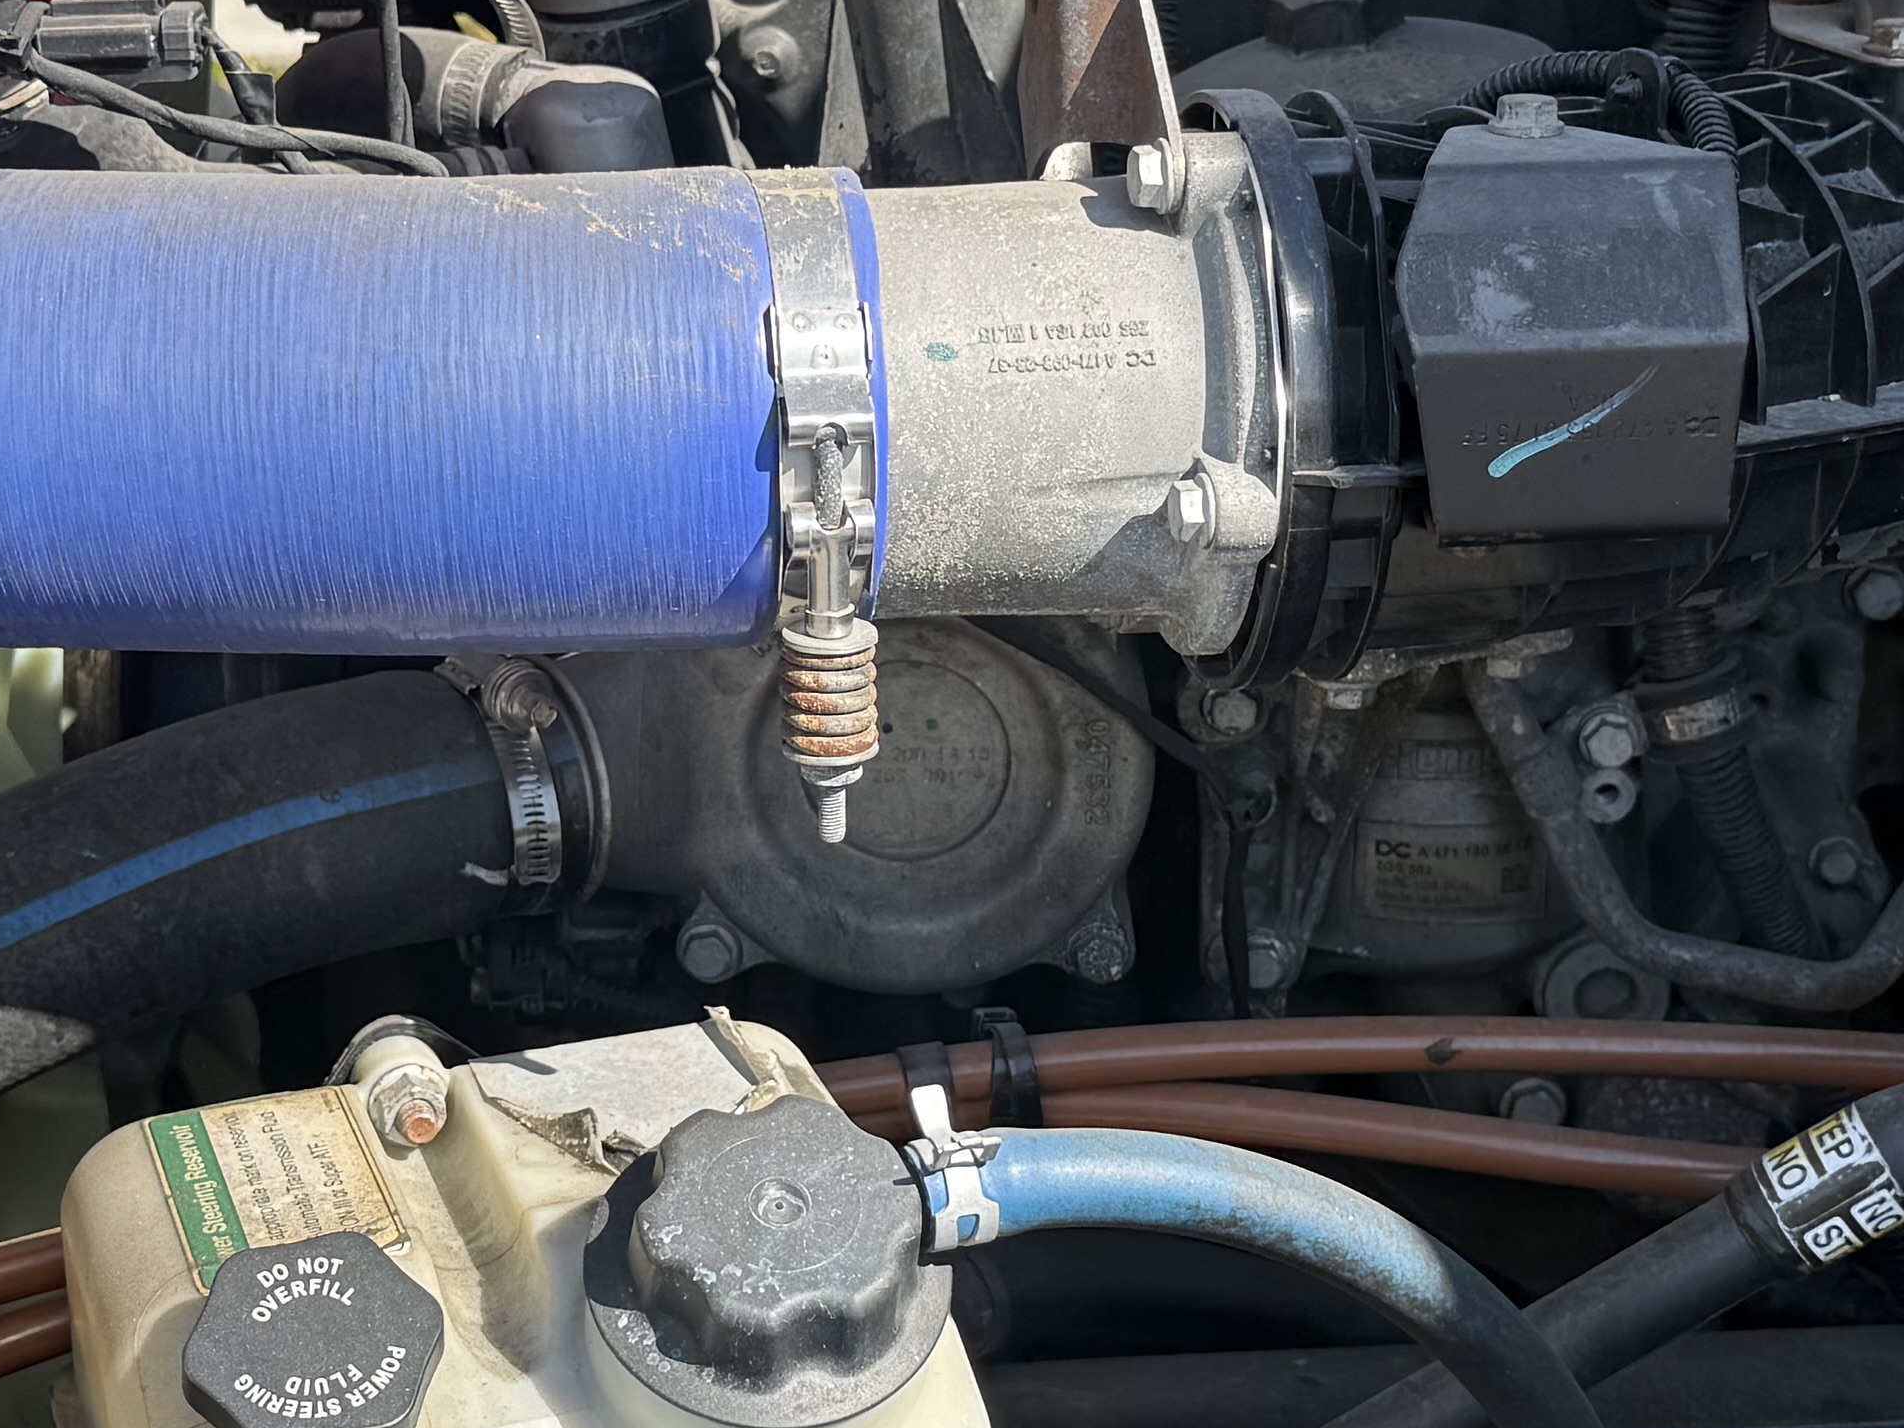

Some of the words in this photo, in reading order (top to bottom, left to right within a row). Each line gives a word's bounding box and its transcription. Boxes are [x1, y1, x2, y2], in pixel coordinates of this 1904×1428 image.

[1375, 840, 1411, 858] DC
[1417, 849, 1428, 858] A
[173, 1125, 209, 1181] Reservoir
[239, 1149, 255, 1165] on
[269, 1133, 305, 1194] Transmission
[1767, 1145, 1808, 1191] NO
[243, 1165, 261, 1186] mark
[322, 1162, 343, 1188] Super
[194, 1181, 228, 1234] Steering
[252, 1188, 286, 1240] appropriate
[332, 1191, 348, 1201] or
[1857, 1196, 1902, 1233] NO
[212, 1236, 237, 1259] wer
[256, 1263, 290, 1289] DO
[298, 1256, 344, 1276] NOT
[251, 1278, 356, 1323] OVERFILL
[284, 1364, 363, 1396] FLUID
[352, 1345, 406, 1407] POWER
[234, 1373, 343, 1419] STEERING
